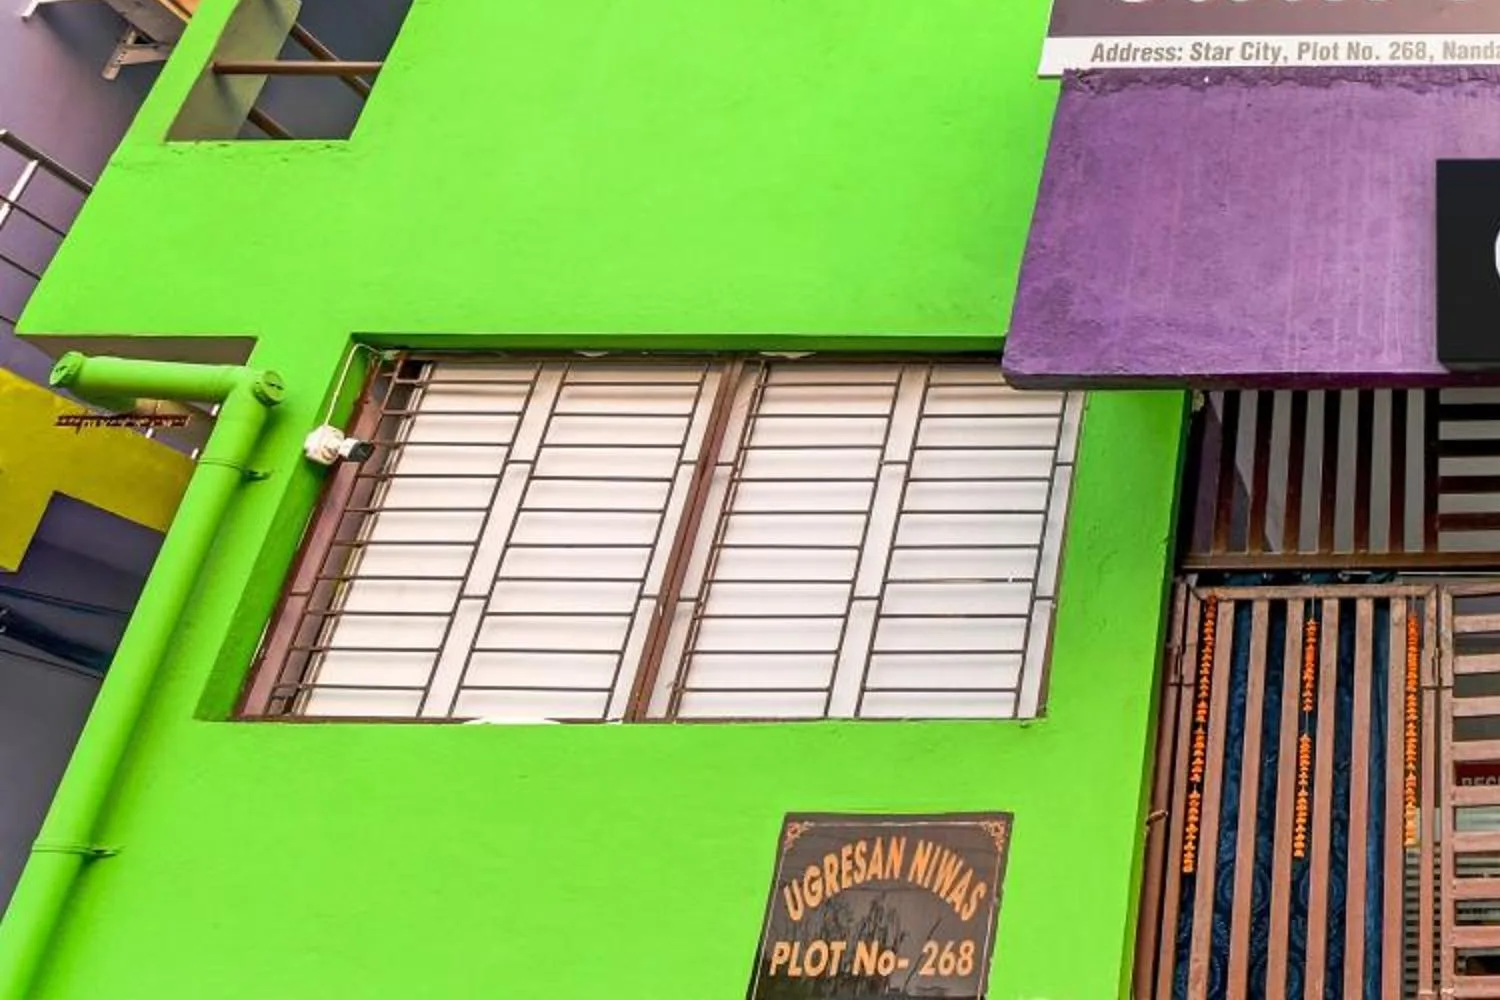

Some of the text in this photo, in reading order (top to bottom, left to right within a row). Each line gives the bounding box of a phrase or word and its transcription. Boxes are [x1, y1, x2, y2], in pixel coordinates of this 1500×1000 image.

[1091, 42, 1183, 62] Address:
[1190, 42, 1234, 61] Star
[1240, 41, 1289, 64] City,
[1297, 41, 1340, 61] Plot
[1347, 40, 1380, 60] No.
[1389, 40, 1434, 62] 268,
[783, 836, 988, 921] UGRESAN NIWAS
[769, 940, 847, 977] PLOT
[918, 939, 975, 977] 268
